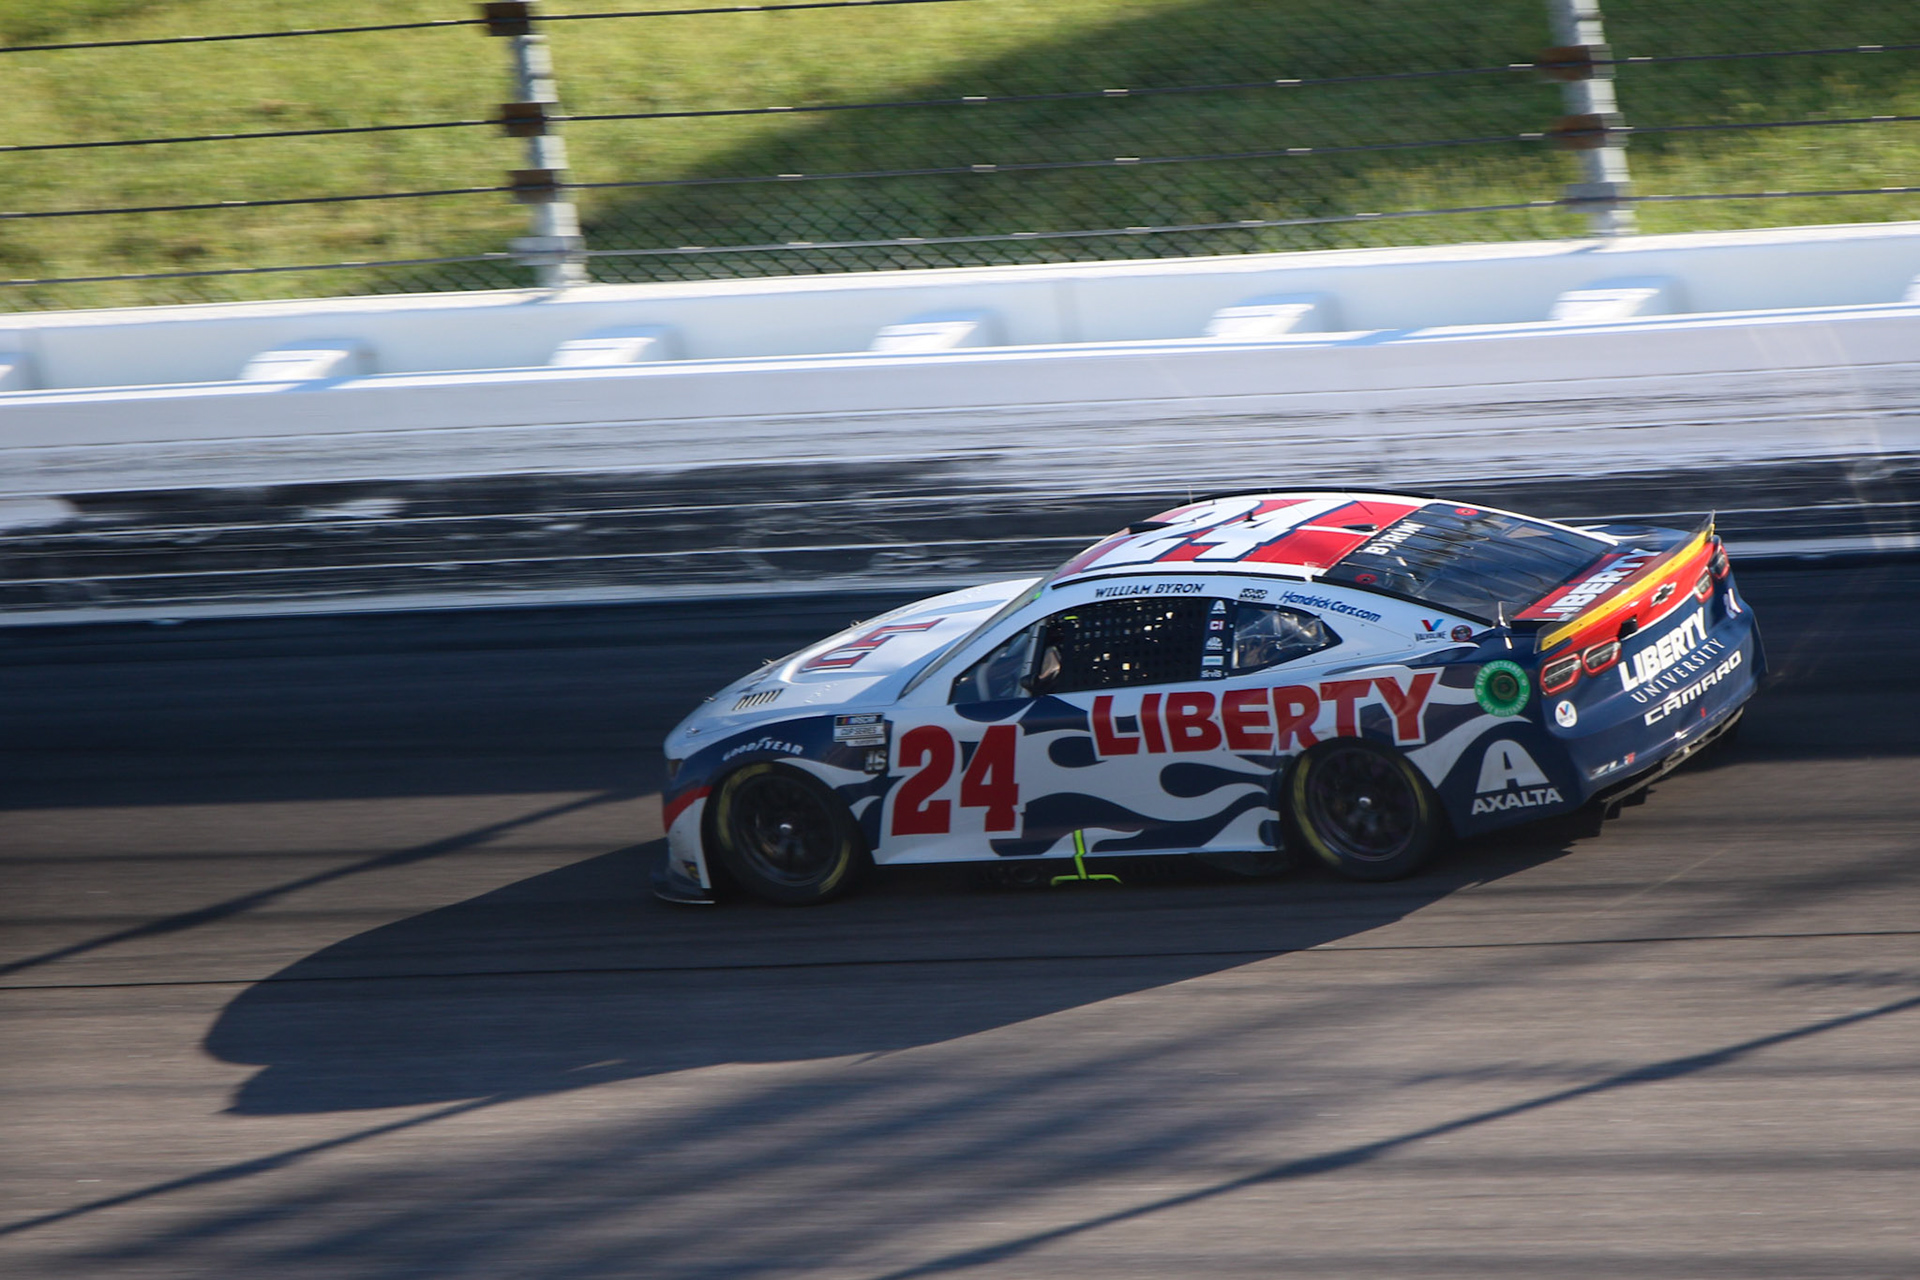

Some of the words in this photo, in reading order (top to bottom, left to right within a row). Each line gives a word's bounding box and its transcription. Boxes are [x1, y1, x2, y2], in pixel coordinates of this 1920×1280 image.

[1083, 499, 1357, 573] 24
[1096, 585, 1152, 598] WILLIAM
[1155, 584, 1205, 594] BYRON
[1618, 606, 1708, 692] LIBERTY
[1630, 638, 1725, 704] UNIVERSITY
[1092, 673, 1437, 757] LIBERTY
[1644, 650, 1742, 726] CAMARO
[722, 737, 804, 762] GOODYEAR
[891, 724, 1019, 836] 24
[1471, 788, 1565, 815] AXALTA
